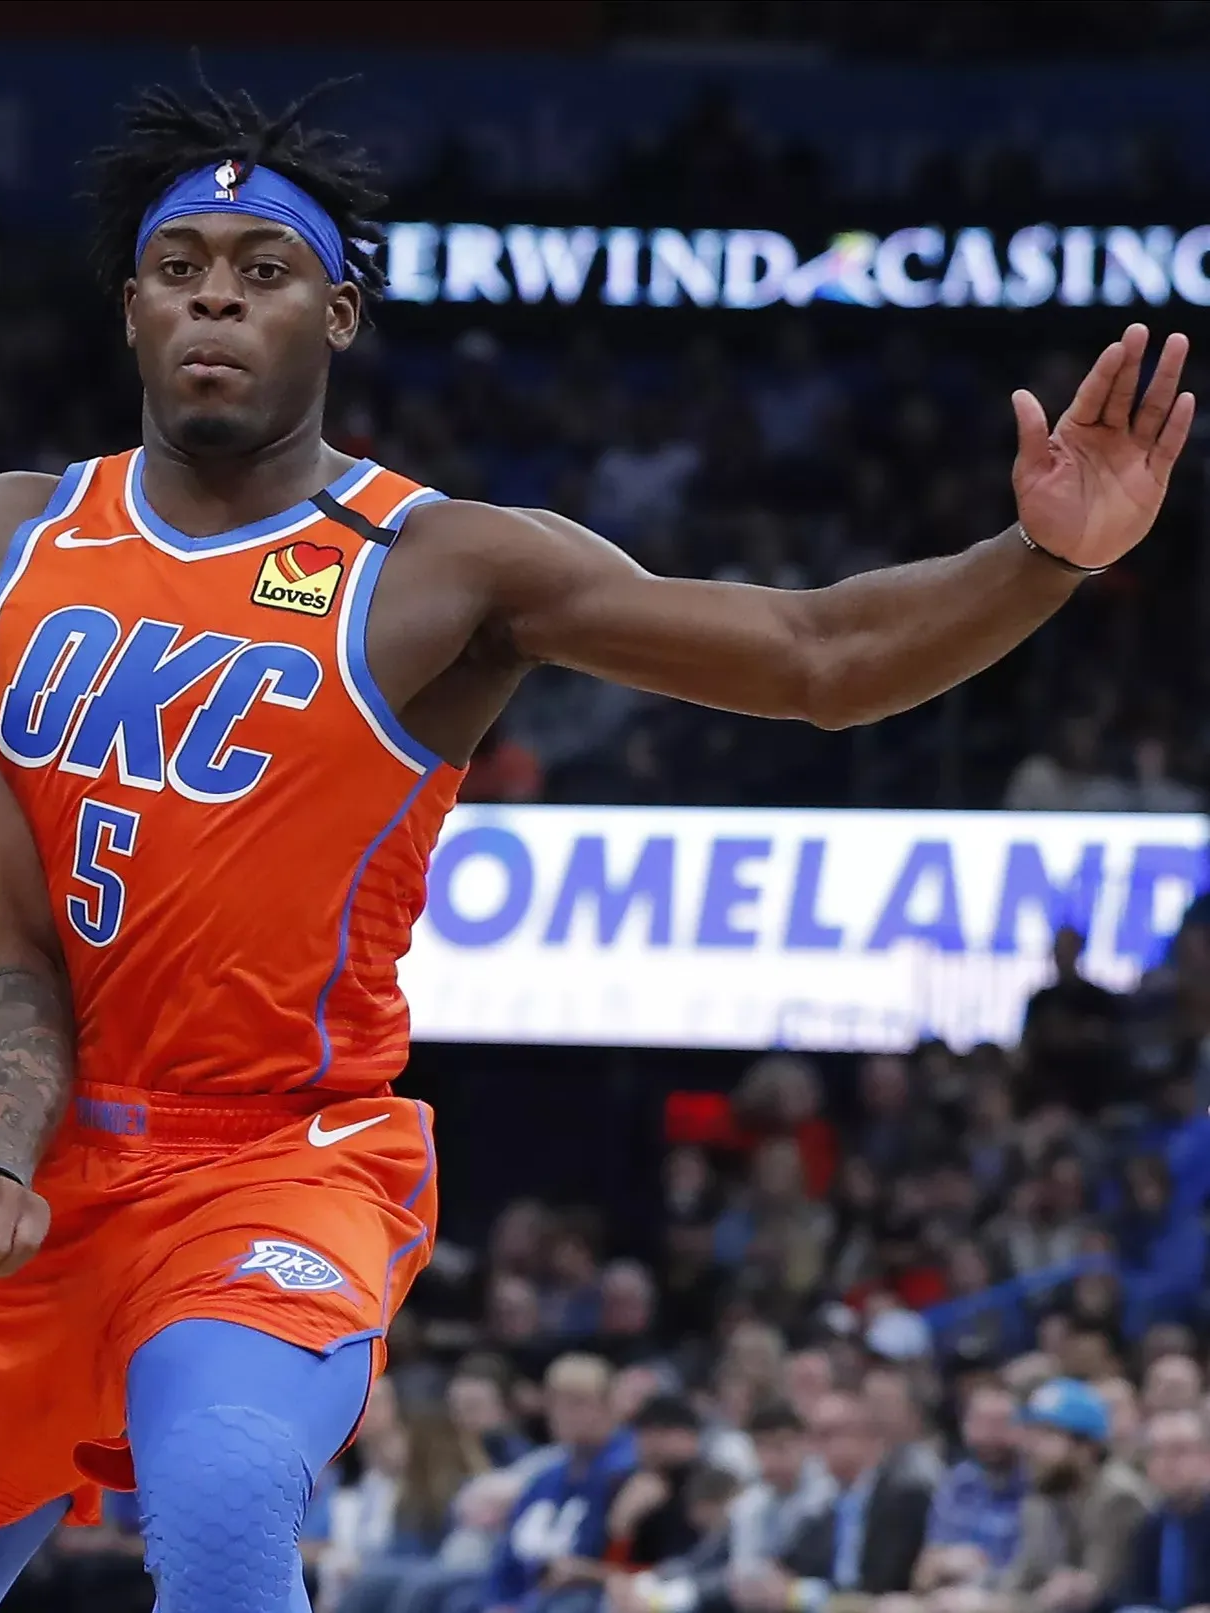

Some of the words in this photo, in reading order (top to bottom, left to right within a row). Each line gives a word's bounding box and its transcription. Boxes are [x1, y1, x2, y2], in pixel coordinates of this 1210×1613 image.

[384, 221, 798, 309] ERWIND
[66, 798, 140, 947] 5
[241, 1250, 326, 1276] OKC
